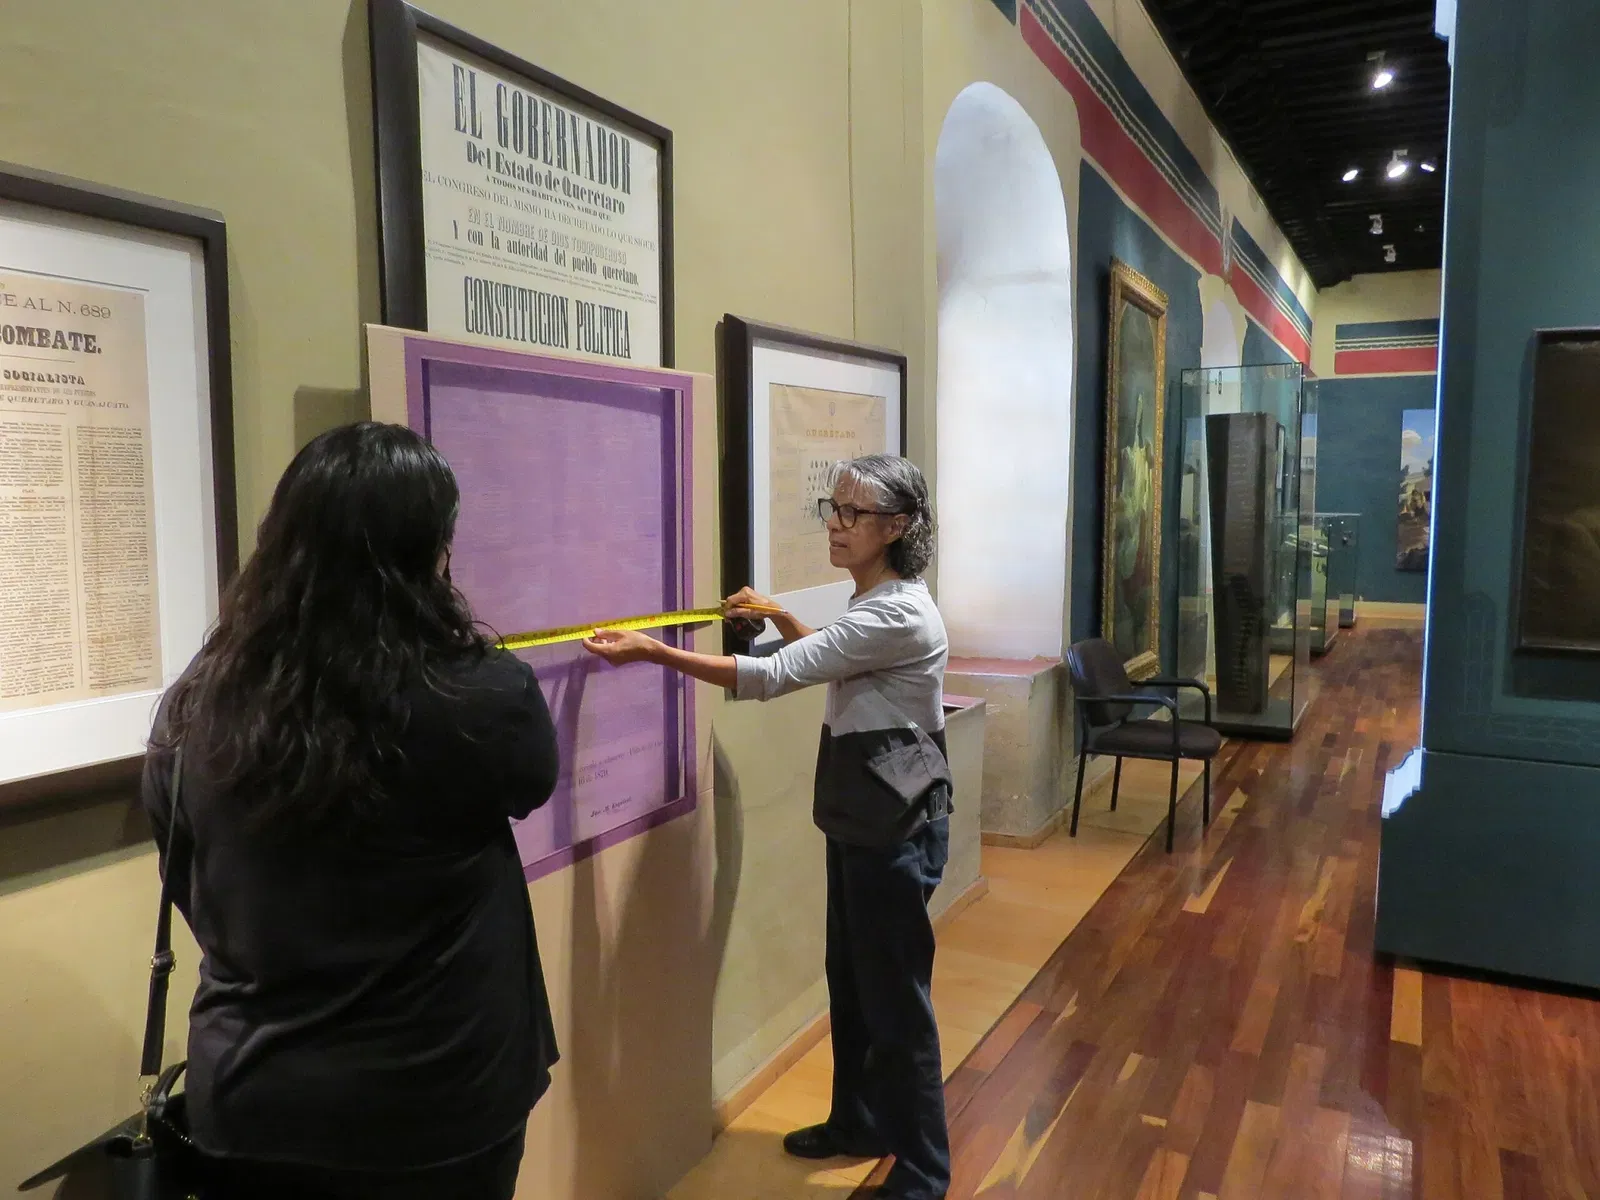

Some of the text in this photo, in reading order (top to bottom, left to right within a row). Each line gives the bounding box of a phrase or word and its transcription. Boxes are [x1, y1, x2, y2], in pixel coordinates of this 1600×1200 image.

[452, 63, 631, 195] EL GOBERNADOR
[466, 140, 491, 170] Del
[495, 151, 542, 187] Estado
[544, 170, 560, 193] de
[492, 176, 517, 190] TODOS
[517, 185, 530, 195] SUS
[437, 175, 491, 201] CONGRESO
[492, 193, 513, 207] DEL
[514, 200, 541, 217] MISMO
[544, 208, 556, 221] HA
[559, 212, 605, 235] DECRETADO
[606, 227, 617, 239] LO
[467, 228, 483, 246] con
[491, 231, 500, 251] la
[507, 238, 548, 264] autoridad
[554, 247, 566, 268] del
[572, 256, 597, 274] pueblo
[468, 207, 627, 266] EN EL NOMBRE DE DIOS TODOPODEROSO
[0, 293, 112, 320] E AL N. 689
[464, 275, 632, 359] CONSTITUCION POLITICA
[0, 323, 103, 355] OMBATE.
[3, 369, 85, 386] SOCIALISTA
[7, 396, 64, 406] QUERETARO
[66, 398, 72, 406] Y
